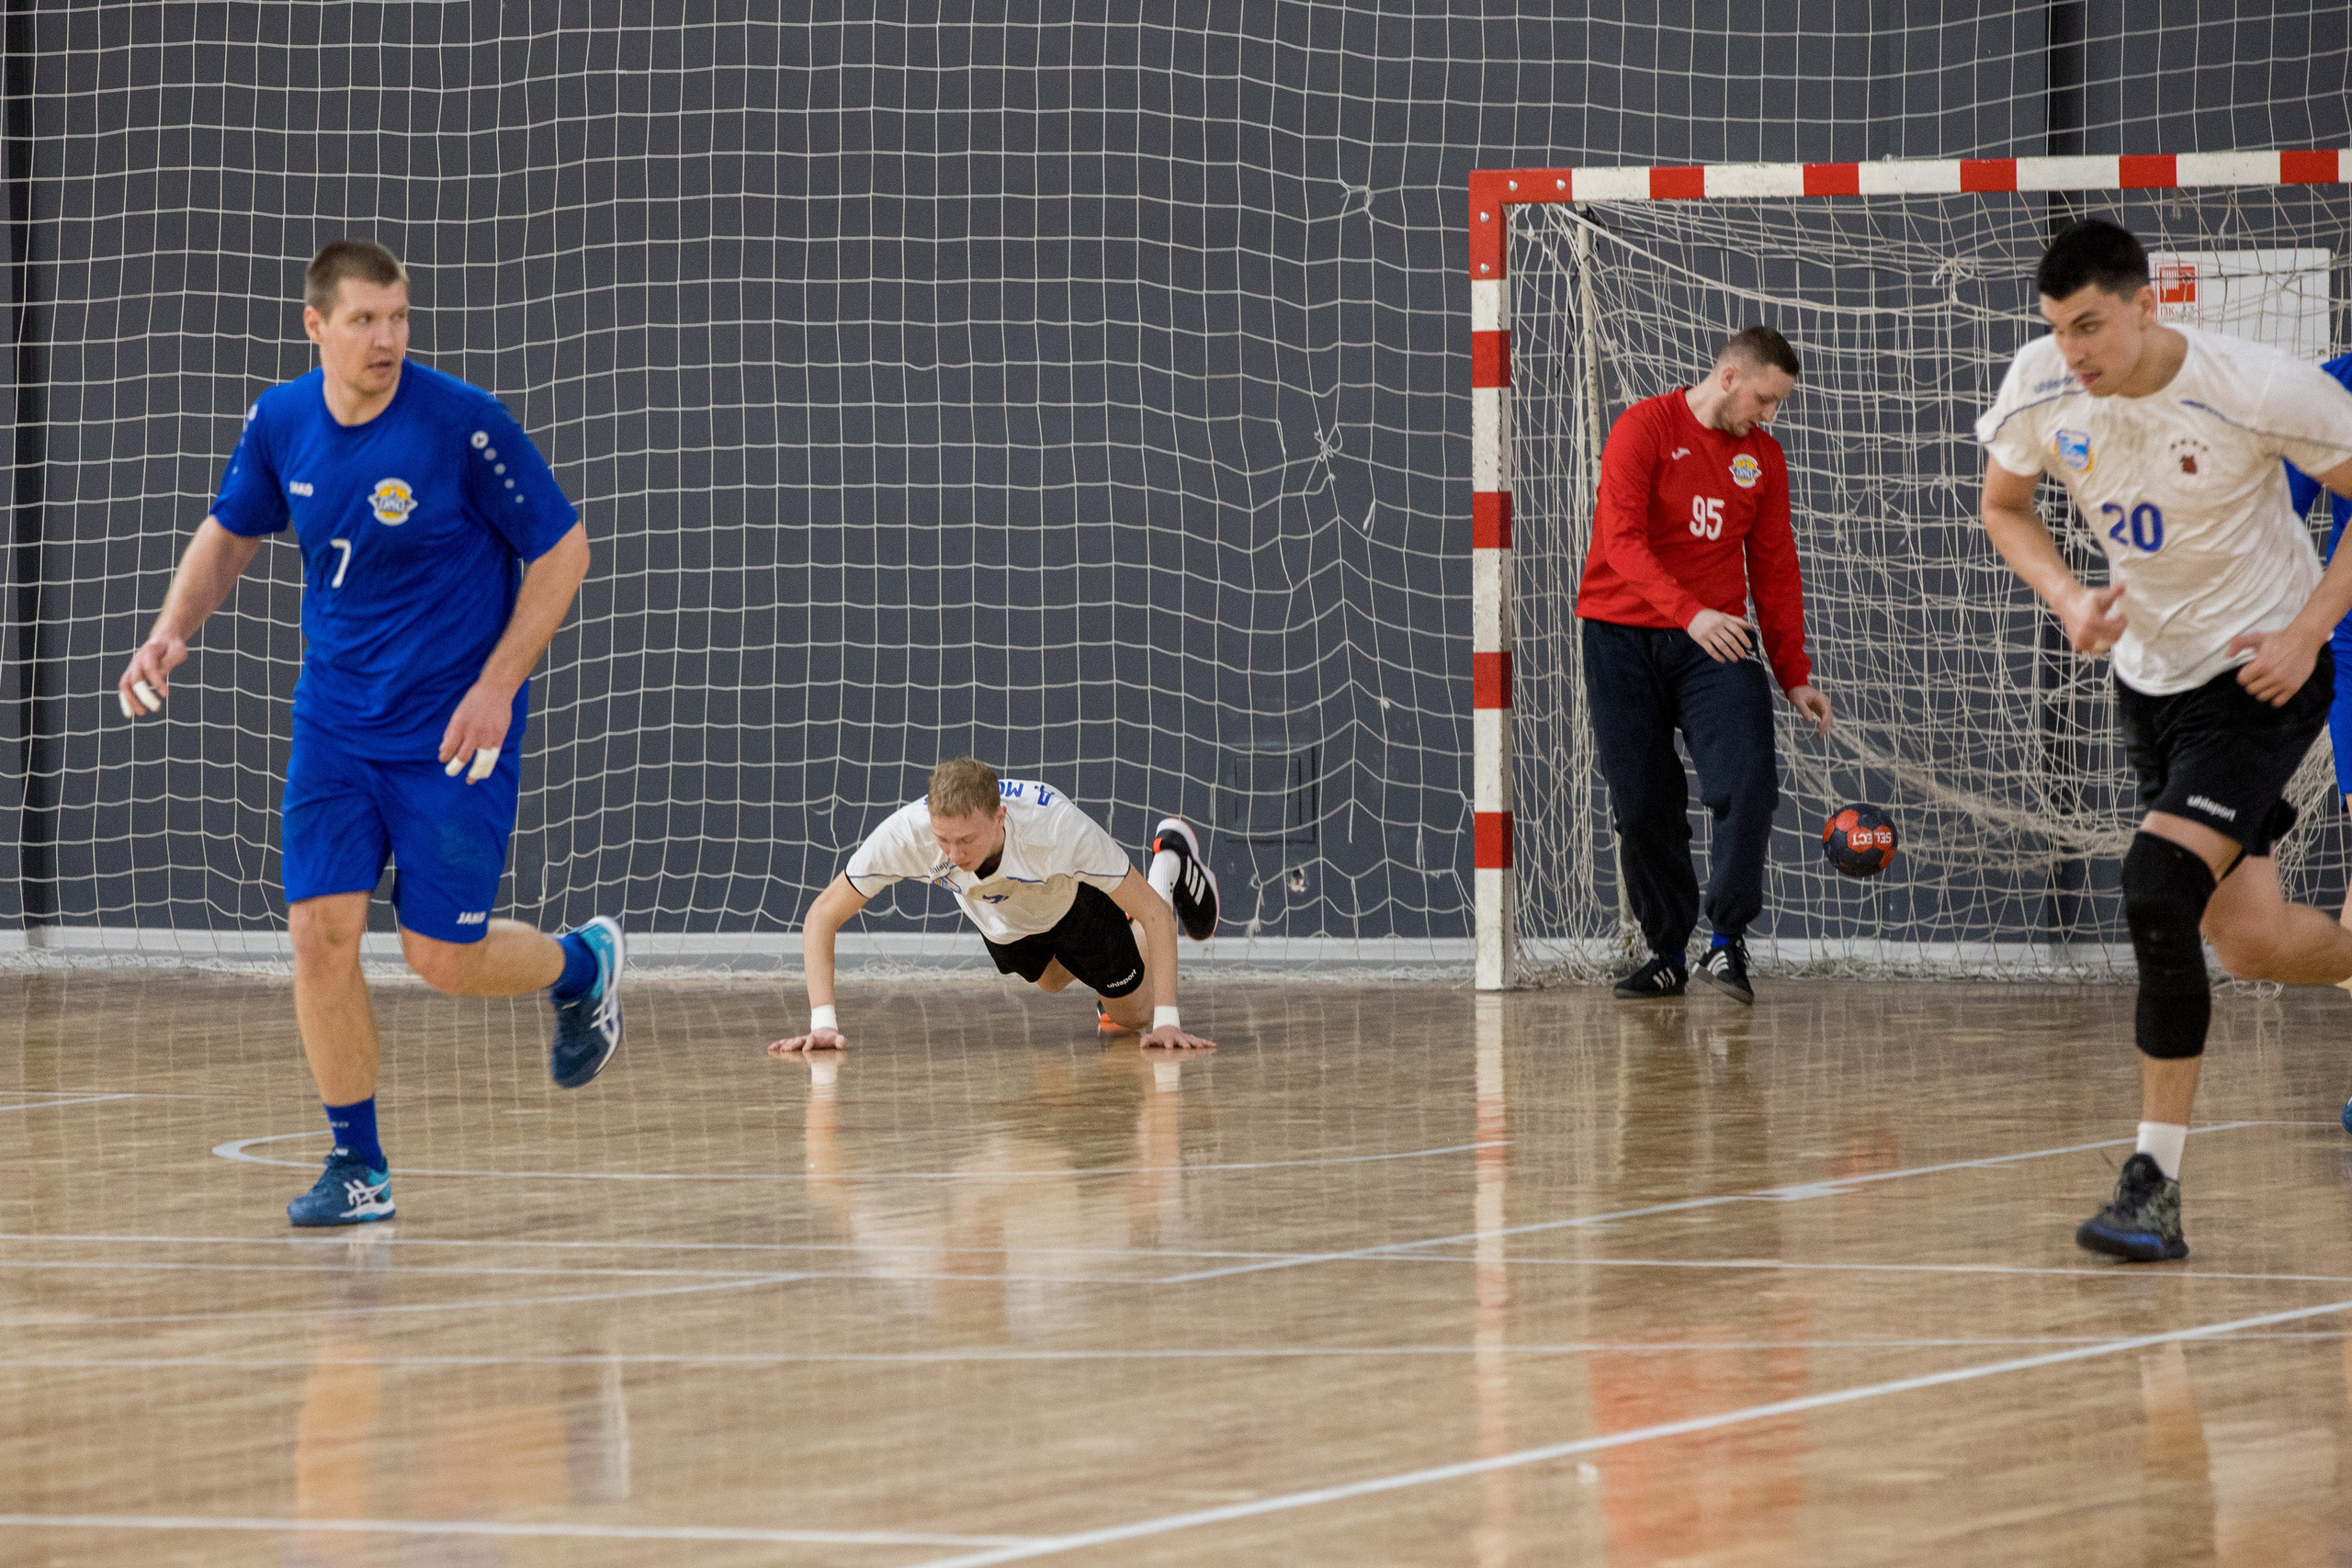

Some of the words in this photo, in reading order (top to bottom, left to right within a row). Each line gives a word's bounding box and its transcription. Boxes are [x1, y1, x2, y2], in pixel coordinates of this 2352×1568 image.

[1689, 494, 1725, 541] 95
[2101, 502, 2164, 553] 20
[331, 538, 352, 589] 7
[1852, 831, 1892, 846] SELECT
[1106, 968, 1137, 988] uhlsport
